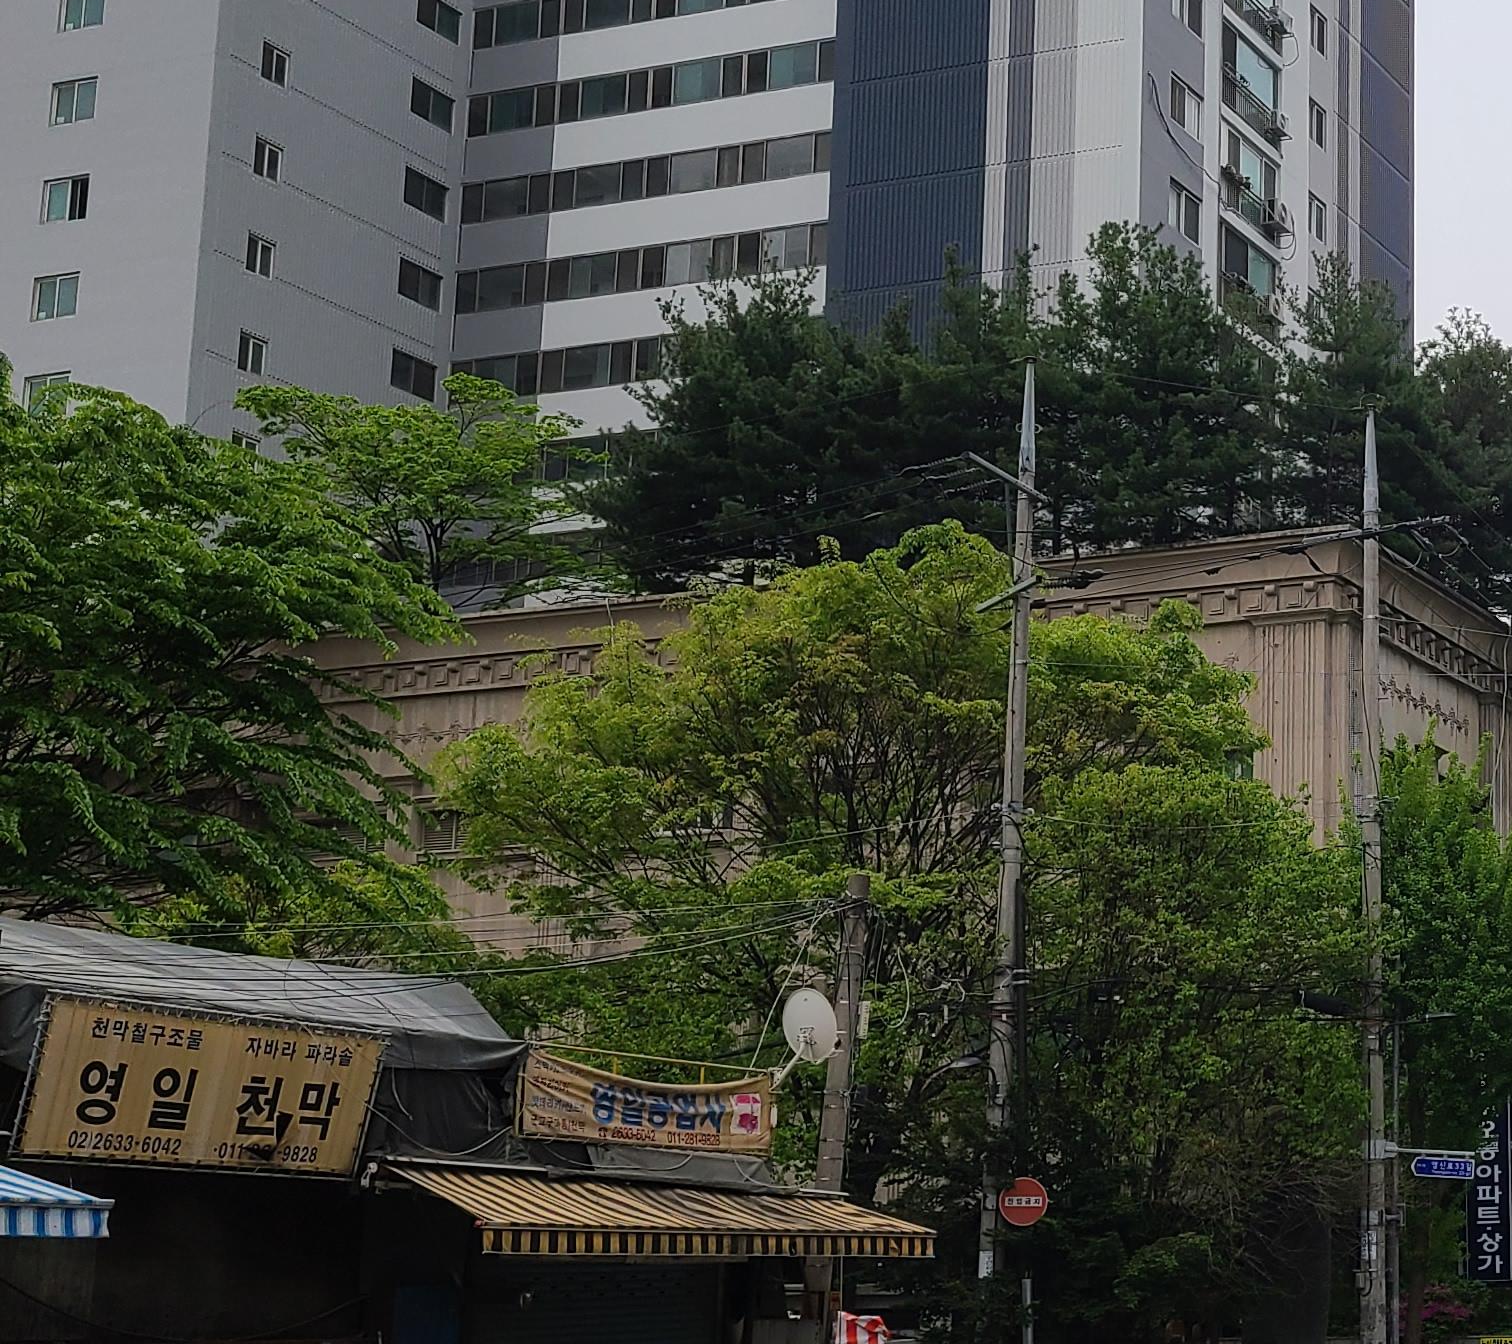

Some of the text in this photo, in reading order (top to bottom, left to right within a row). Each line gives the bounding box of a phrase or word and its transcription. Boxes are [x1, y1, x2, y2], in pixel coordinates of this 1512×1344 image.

[92, 1017, 353, 1066] 천막철구조물 자바라 파라솔
[1007, 1197, 1041, 1206] 진입금지
